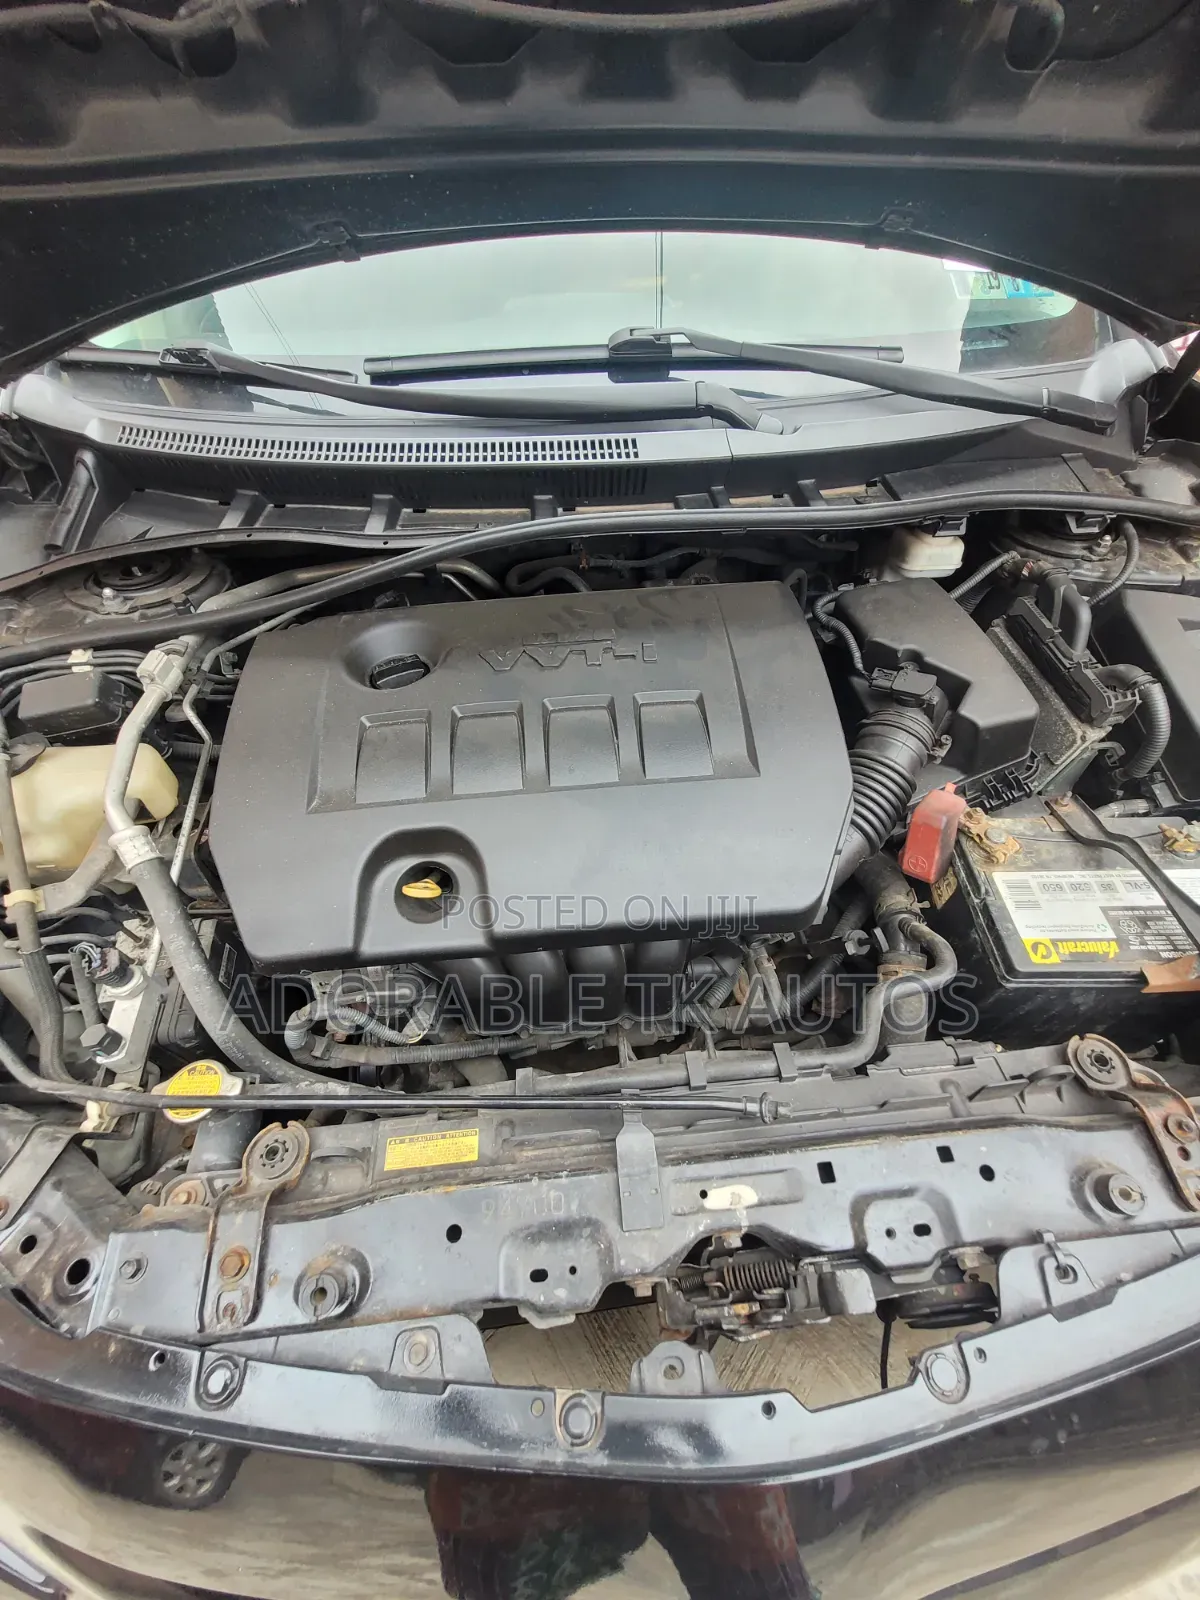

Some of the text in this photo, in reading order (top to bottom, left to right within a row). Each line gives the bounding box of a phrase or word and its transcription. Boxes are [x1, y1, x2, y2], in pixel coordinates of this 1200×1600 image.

[1043, 882, 1152, 892] 5-VL 35 520 650
[413, 1133, 442, 1143] CAUTION
